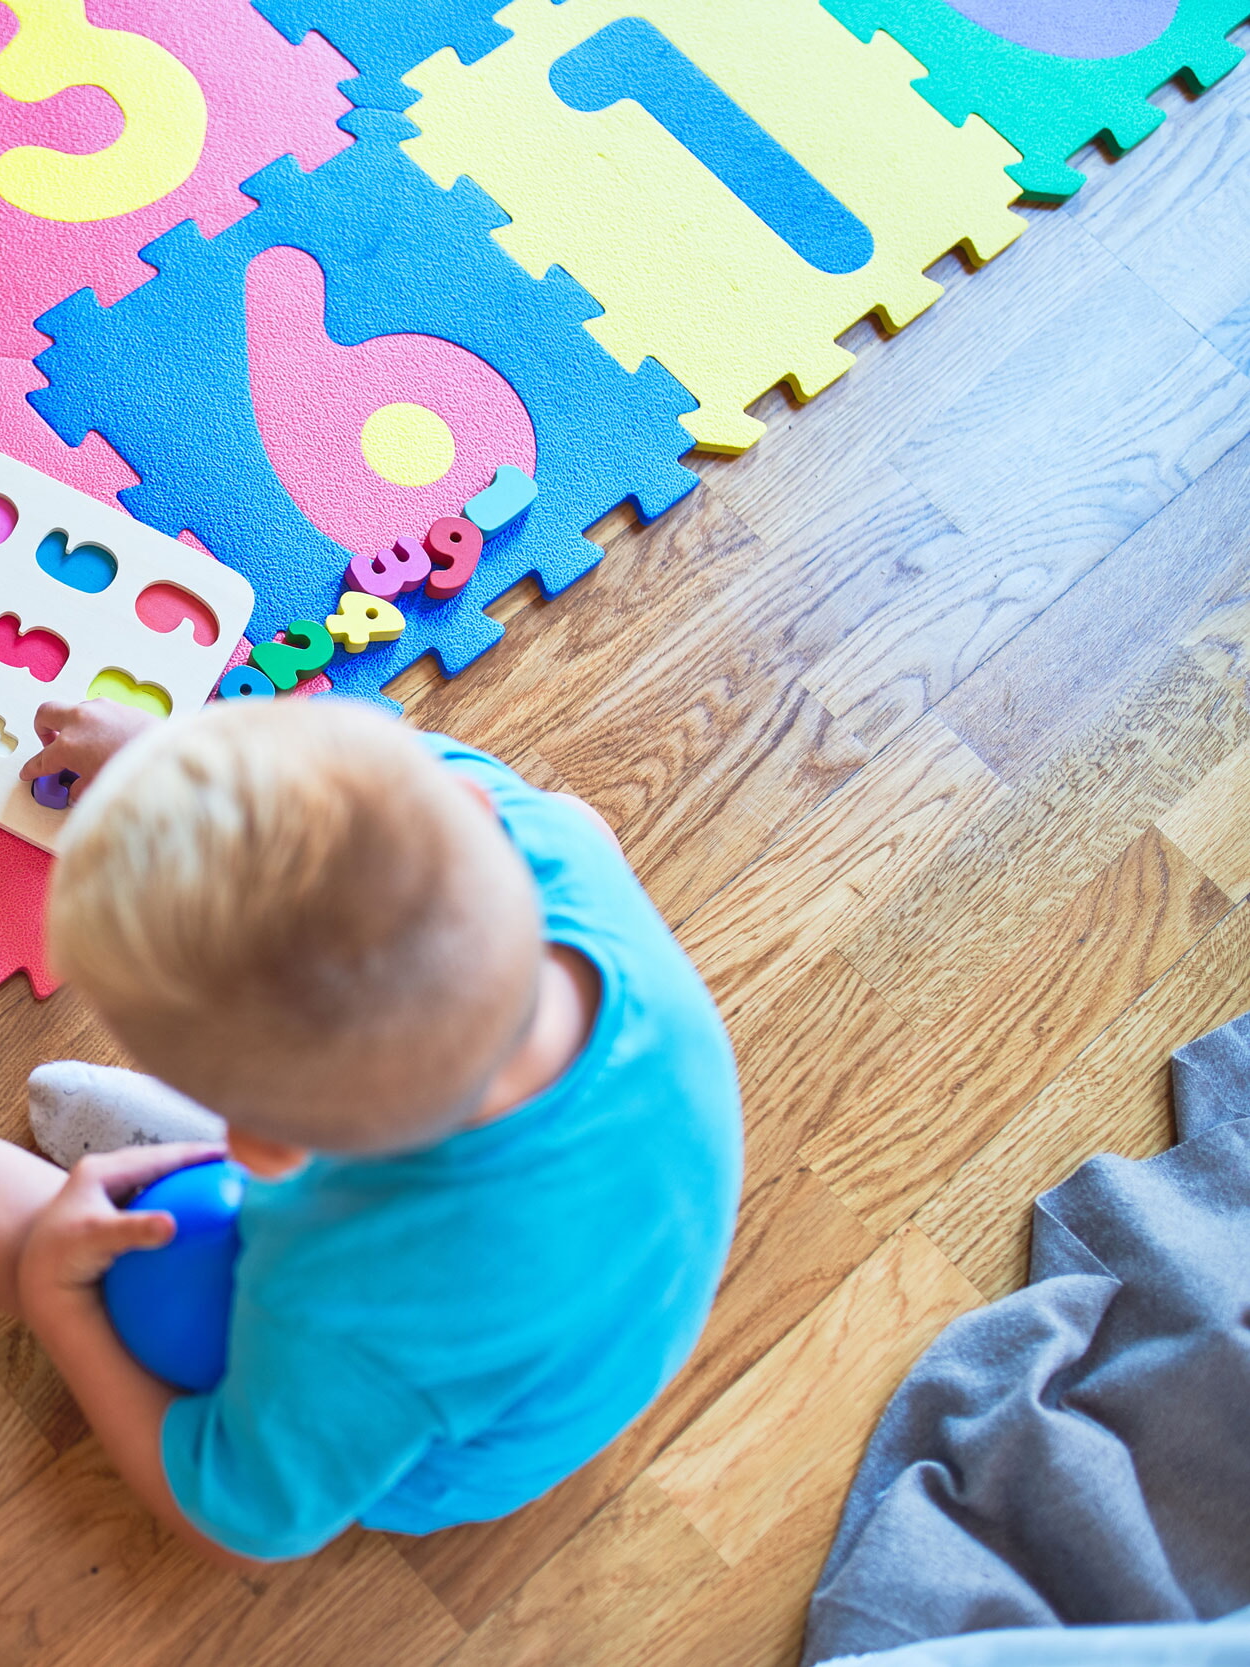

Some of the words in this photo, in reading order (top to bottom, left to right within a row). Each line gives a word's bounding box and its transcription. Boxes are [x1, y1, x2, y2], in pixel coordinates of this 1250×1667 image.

[549, 16, 875, 274] 1
[245, 245, 537, 558] 6
[346, 536, 431, 600] 3
[424, 516, 483, 597] 9
[250, 619, 334, 690] 2
[325, 591, 406, 651] 4
